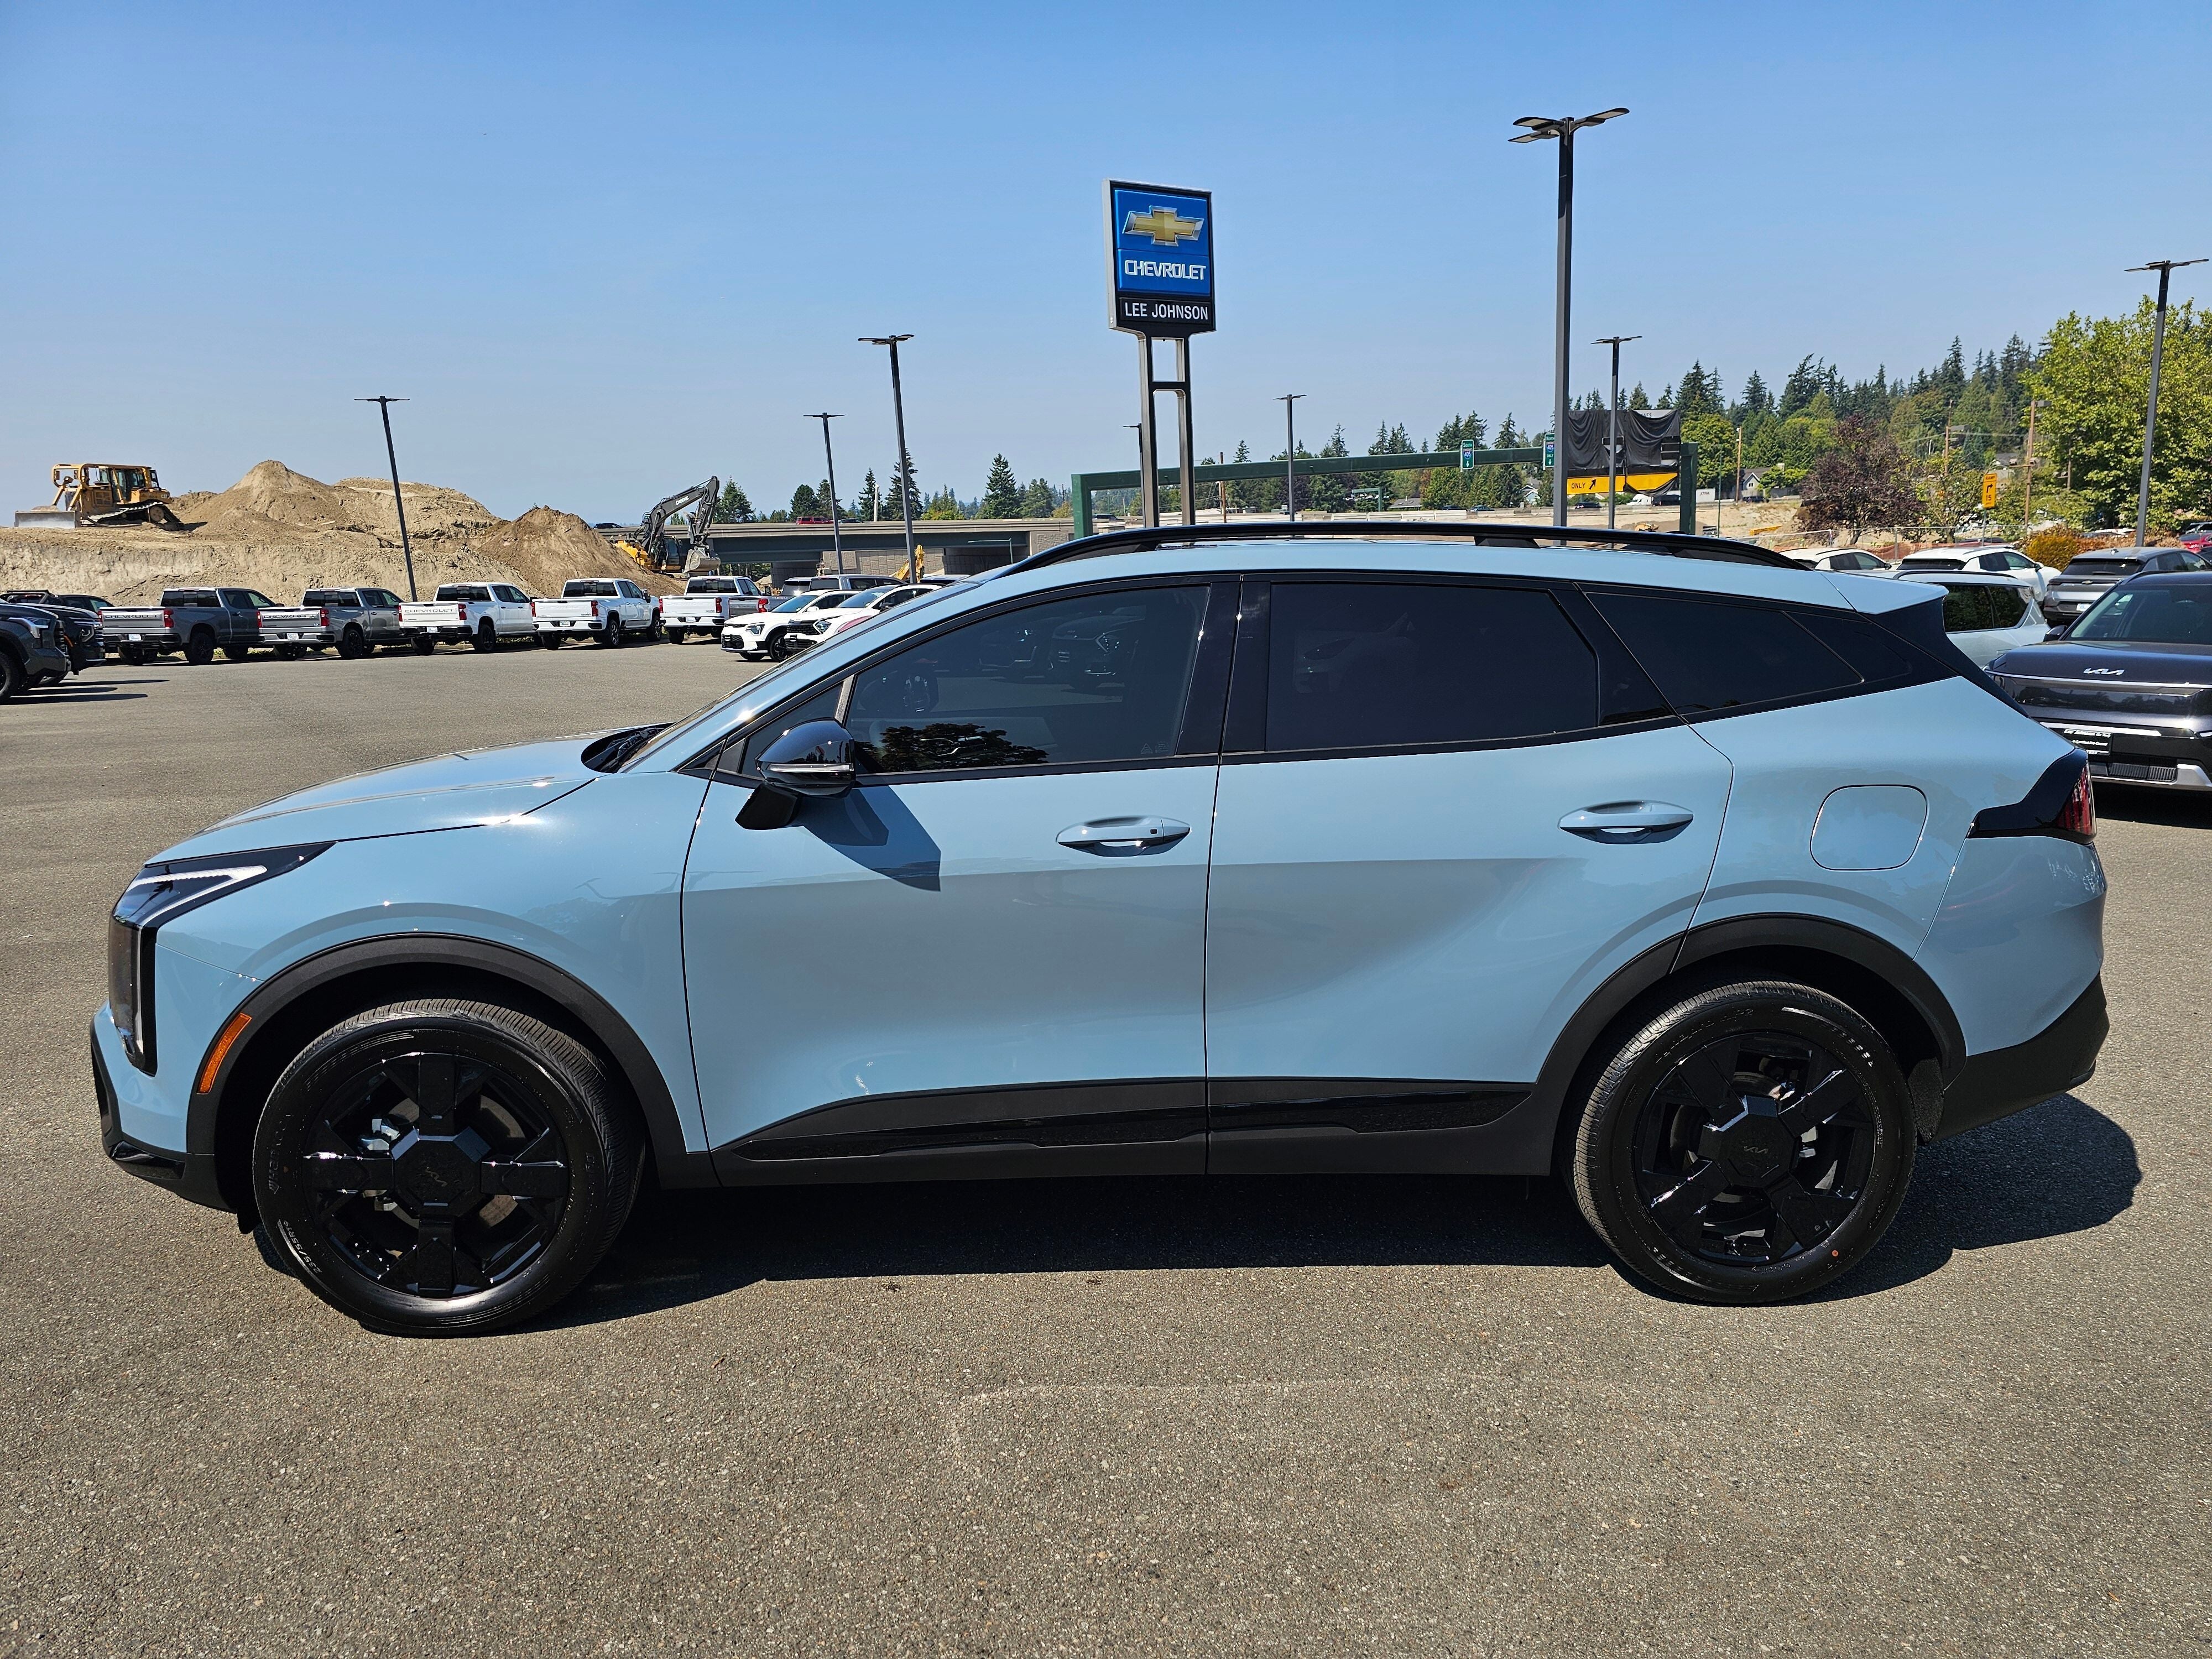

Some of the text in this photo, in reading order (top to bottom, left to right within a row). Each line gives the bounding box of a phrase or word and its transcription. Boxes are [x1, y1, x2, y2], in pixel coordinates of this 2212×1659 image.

[1124, 260, 1206, 280] CHEVROLET
[1125, 302, 1208, 320] LEE JOHNSON
